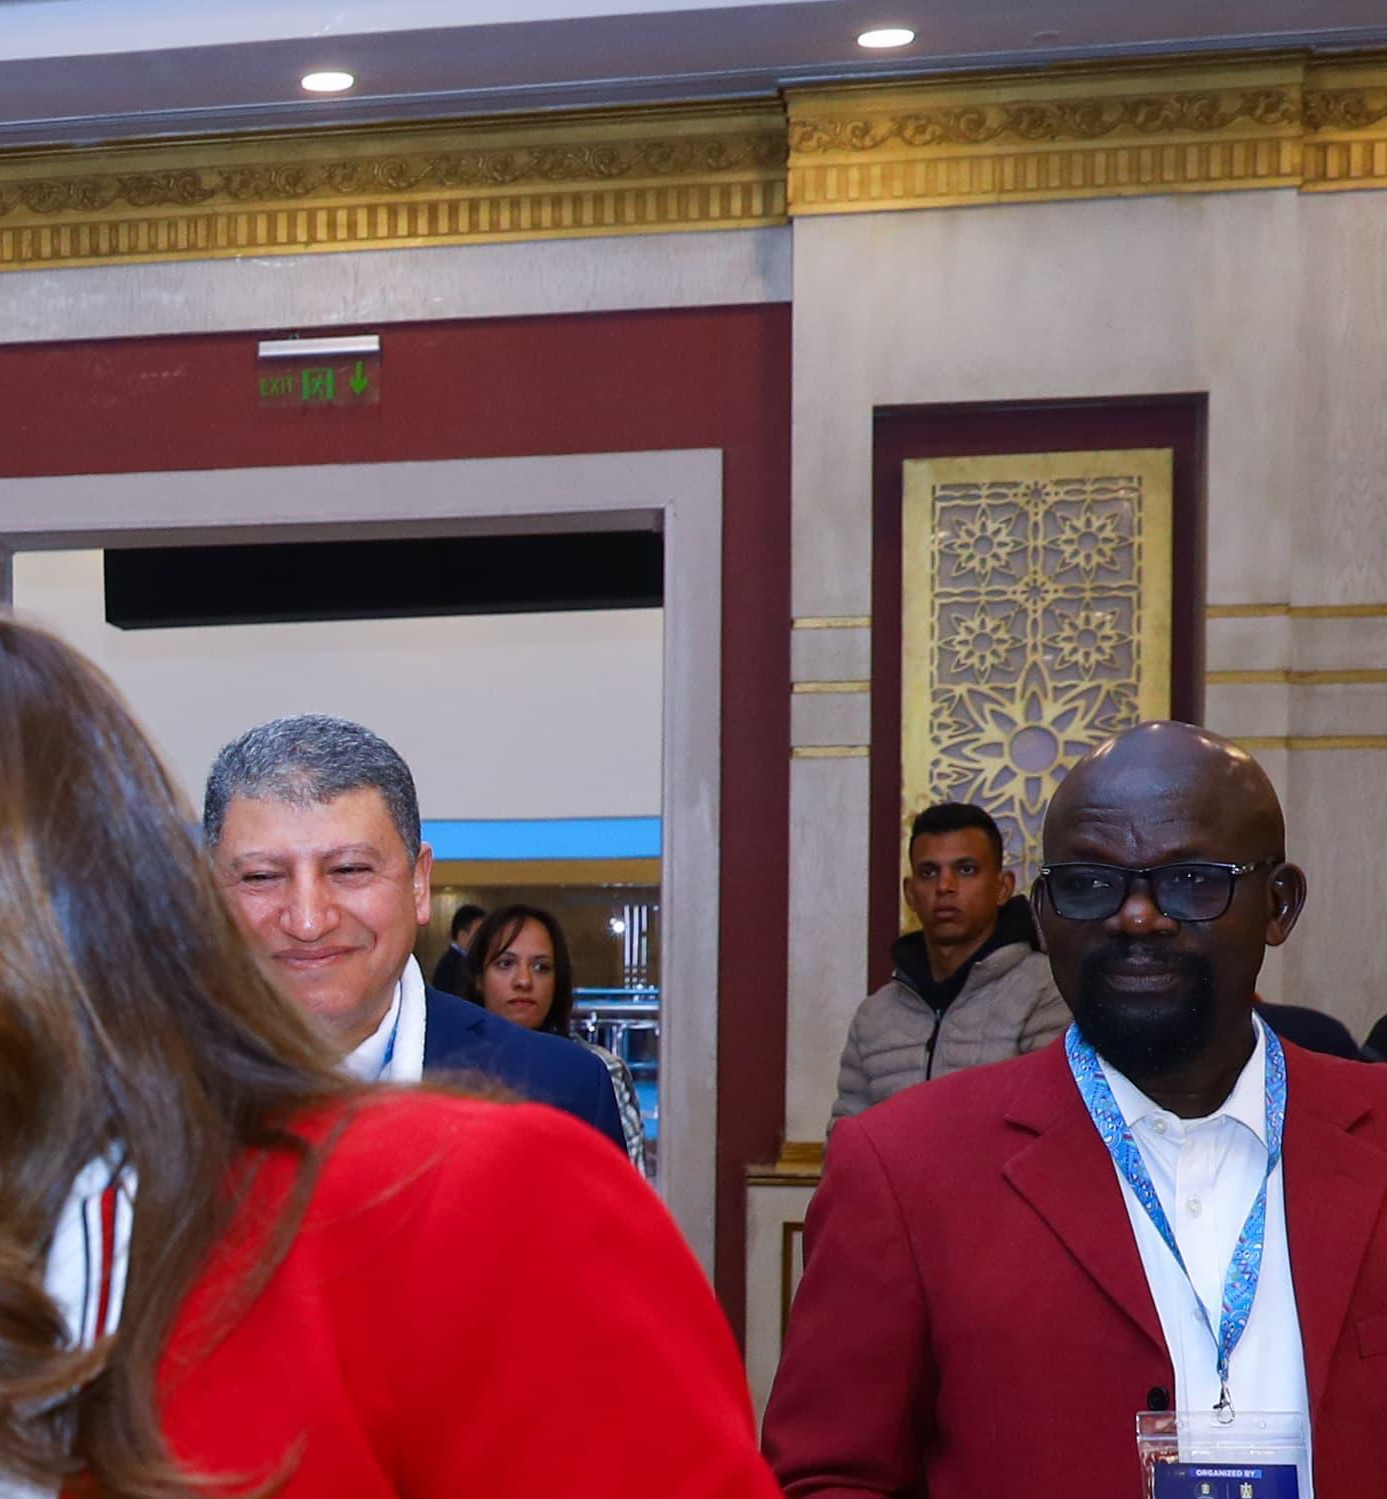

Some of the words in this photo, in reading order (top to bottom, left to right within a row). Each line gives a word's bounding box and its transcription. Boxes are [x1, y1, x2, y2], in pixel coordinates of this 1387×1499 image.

[259, 375, 294, 397] EXIT
[1196, 1468, 1242, 1477] ORGANIZED
[1244, 1469, 1255, 1477] BY
